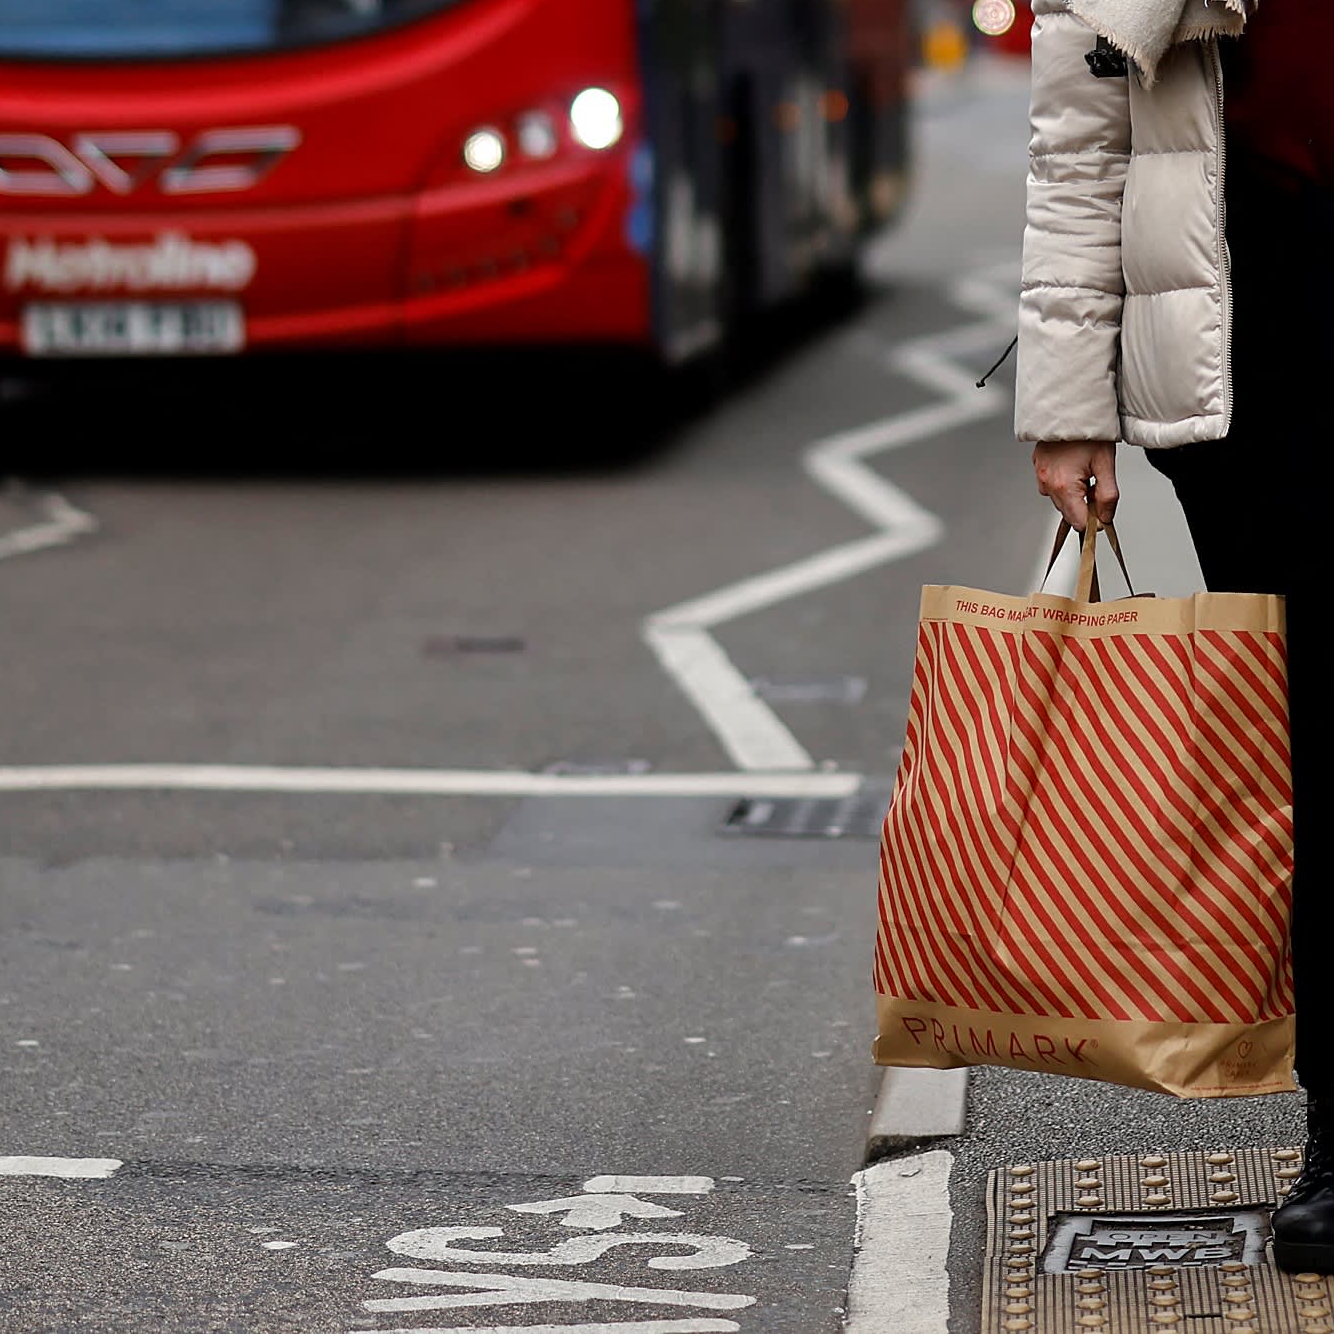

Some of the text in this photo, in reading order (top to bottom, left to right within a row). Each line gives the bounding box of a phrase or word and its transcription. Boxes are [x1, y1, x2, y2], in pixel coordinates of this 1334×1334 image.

[956, 600, 978, 614] THIS
[980, 605, 1005, 619] BAG
[1042, 608, 1106, 626] WRAPPING
[1107, 611, 1138, 625] PAPER
[1081, 1247, 1235, 1260] MWB
